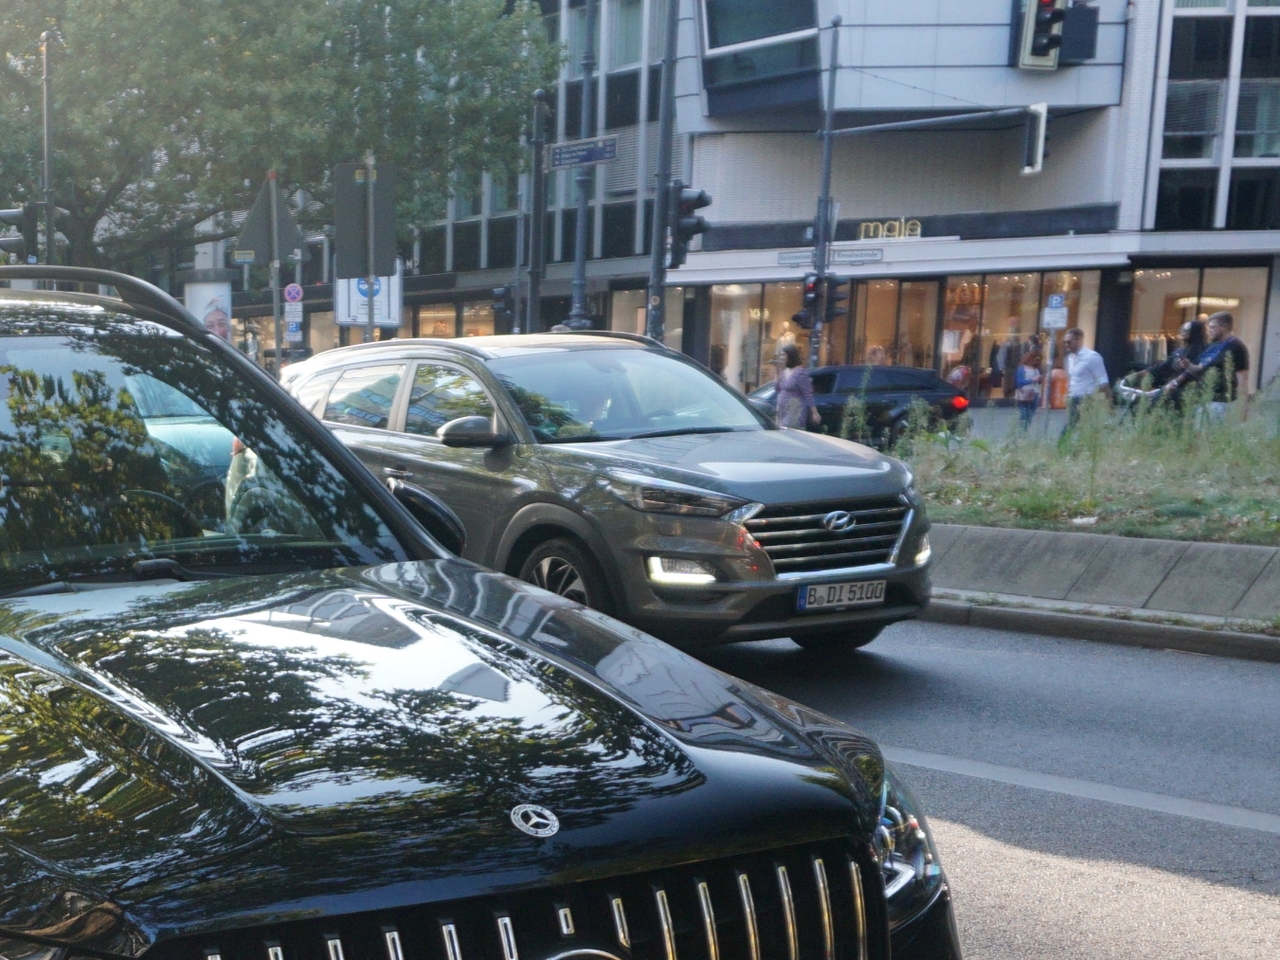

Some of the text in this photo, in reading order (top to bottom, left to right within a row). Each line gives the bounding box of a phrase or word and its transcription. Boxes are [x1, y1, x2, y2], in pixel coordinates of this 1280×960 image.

[860, 216, 922, 240] maje
[808, 588, 818, 605] B
[826, 586, 844, 604] DI
[848, 582, 884, 602] 5100
